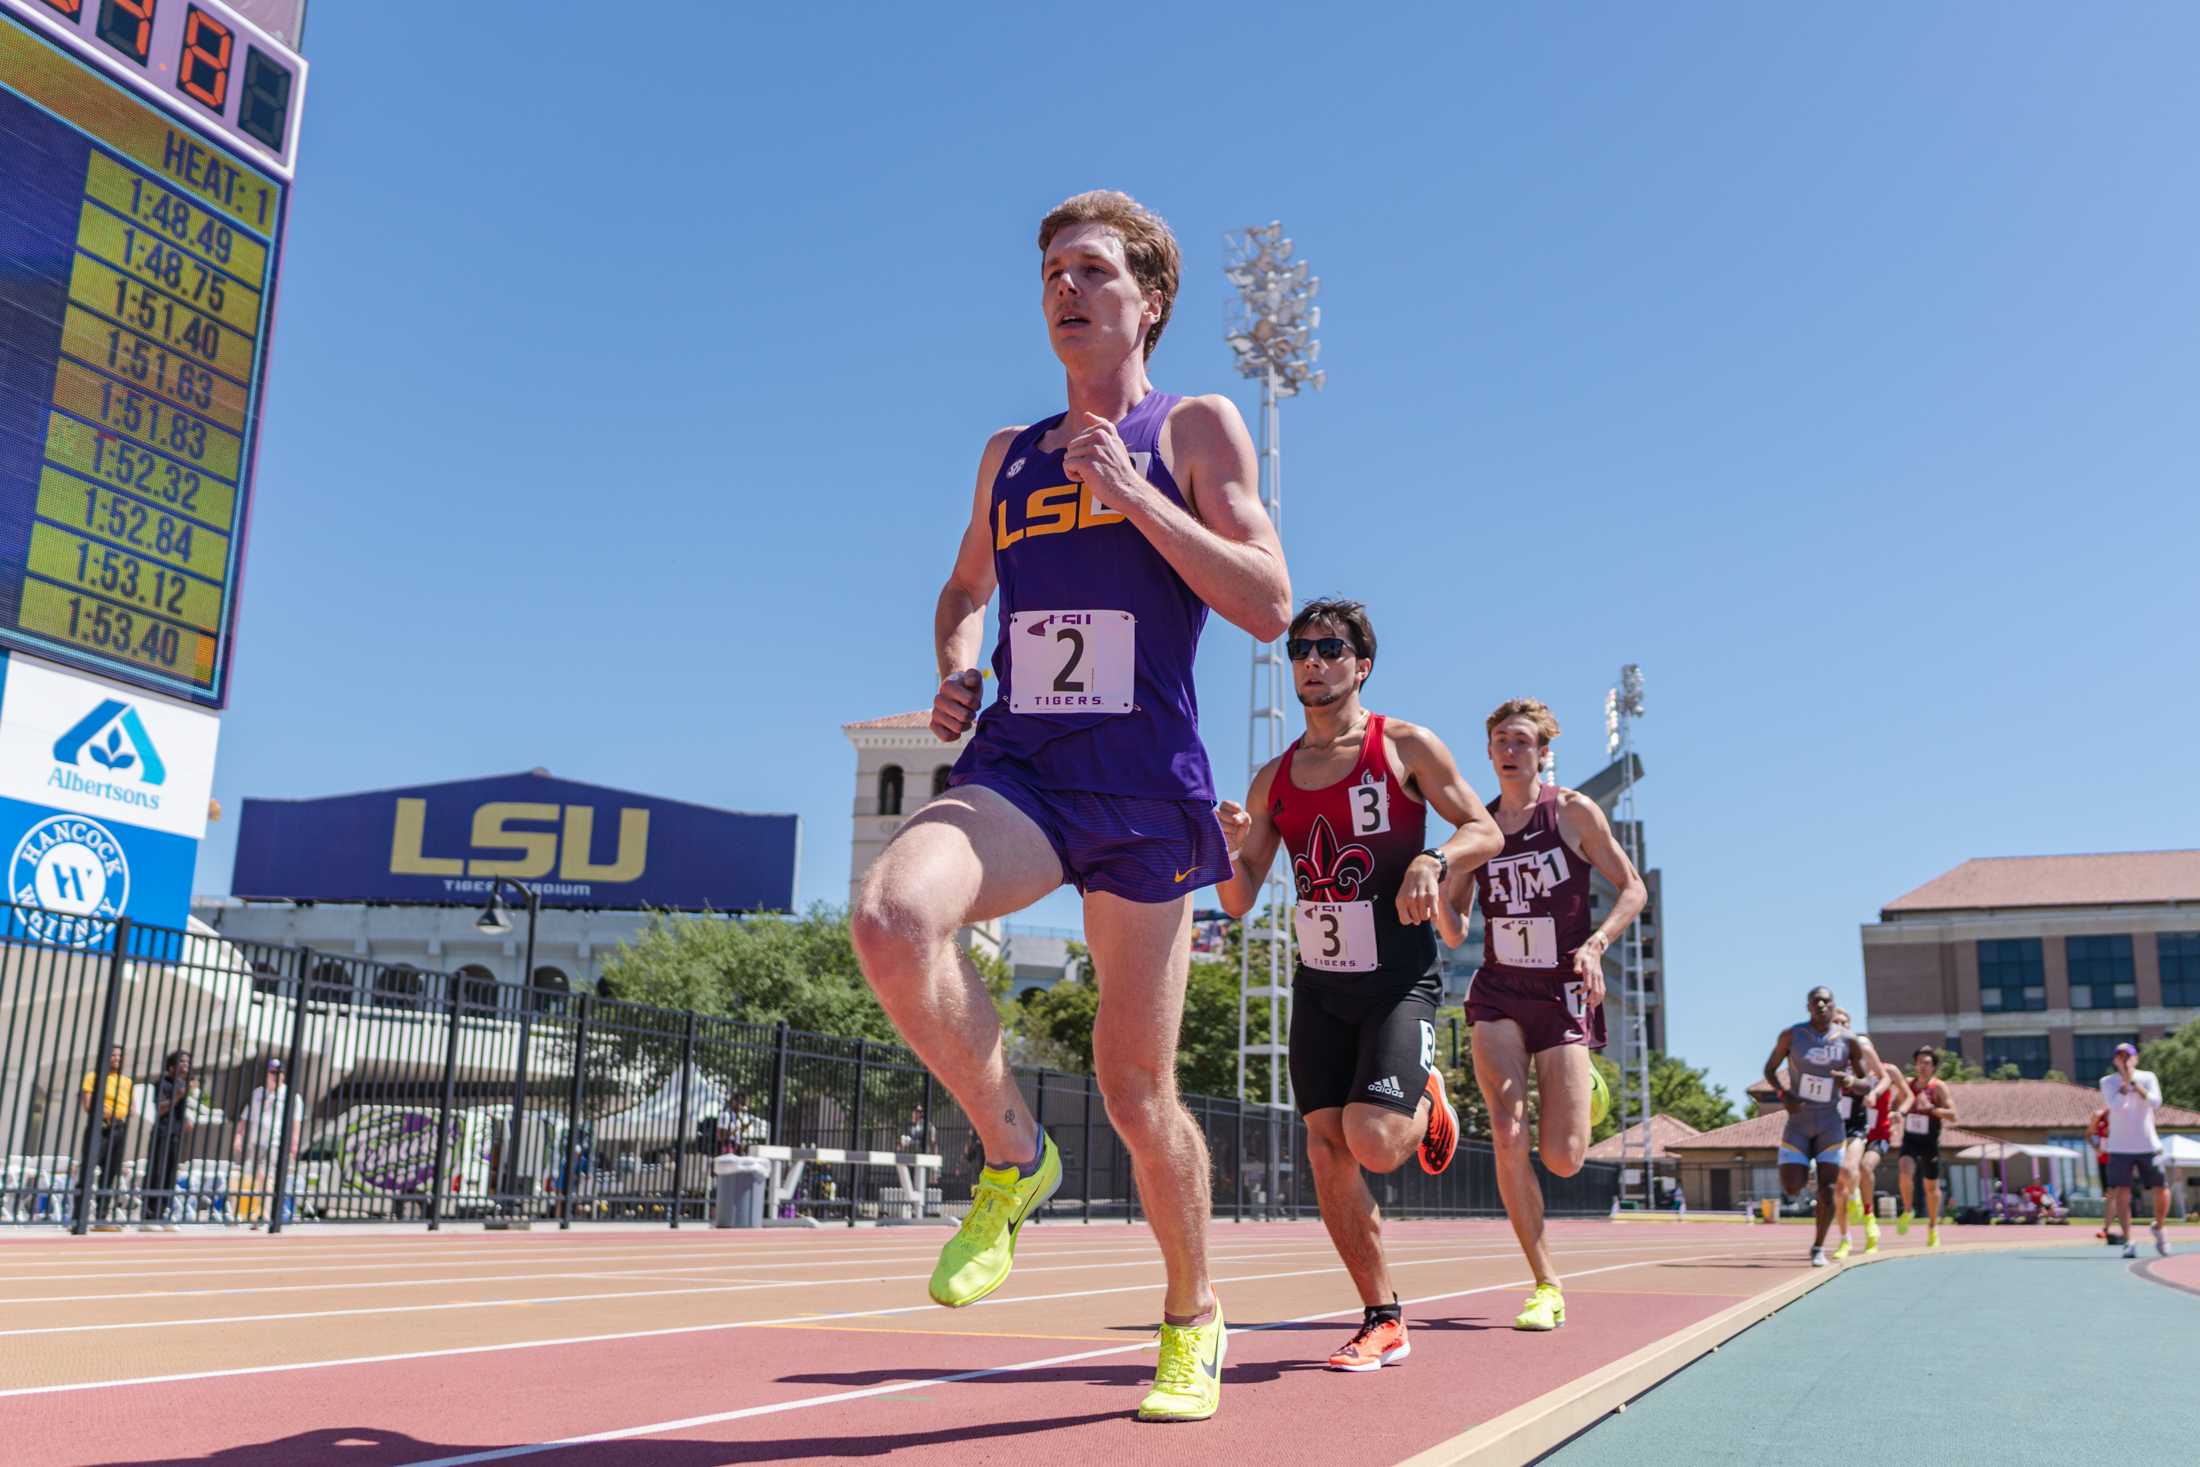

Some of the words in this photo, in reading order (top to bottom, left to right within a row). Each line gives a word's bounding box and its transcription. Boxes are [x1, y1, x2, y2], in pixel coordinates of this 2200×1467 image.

[163, 129, 247, 213] HEAT:
[257, 188, 268, 225] 1
[131, 178, 233, 264] 1:48.49
[124, 228, 227, 312] 1:48.75
[116, 278, 220, 360] 1:51.40
[108, 330, 213, 410] 1:51.63
[100, 381, 207, 460] 1:51.83
[93, 434, 200, 512] 1:52.32
[85, 487, 193, 563] 1:52.84
[77, 543, 187, 615] 1:53.12
[69, 597, 180, 667] 1:53.40
[1053, 628, 1084, 692] 2
[1034, 696, 1102, 705] TIGERS
[48, 766, 160, 810] Albertsons
[1358, 787, 1381, 832] 3
[21, 822, 123, 878] HANCOCK
[390, 798, 650, 883] LSU
[1542, 853, 1561, 881] 1
[1314, 958, 1357, 967] TIGERS
[1320, 914, 1341, 957] 3
[1518, 927, 1529, 957] 1
[1368, 1083, 1405, 1099] adidas
[1810, 1083, 1822, 1096] 11
